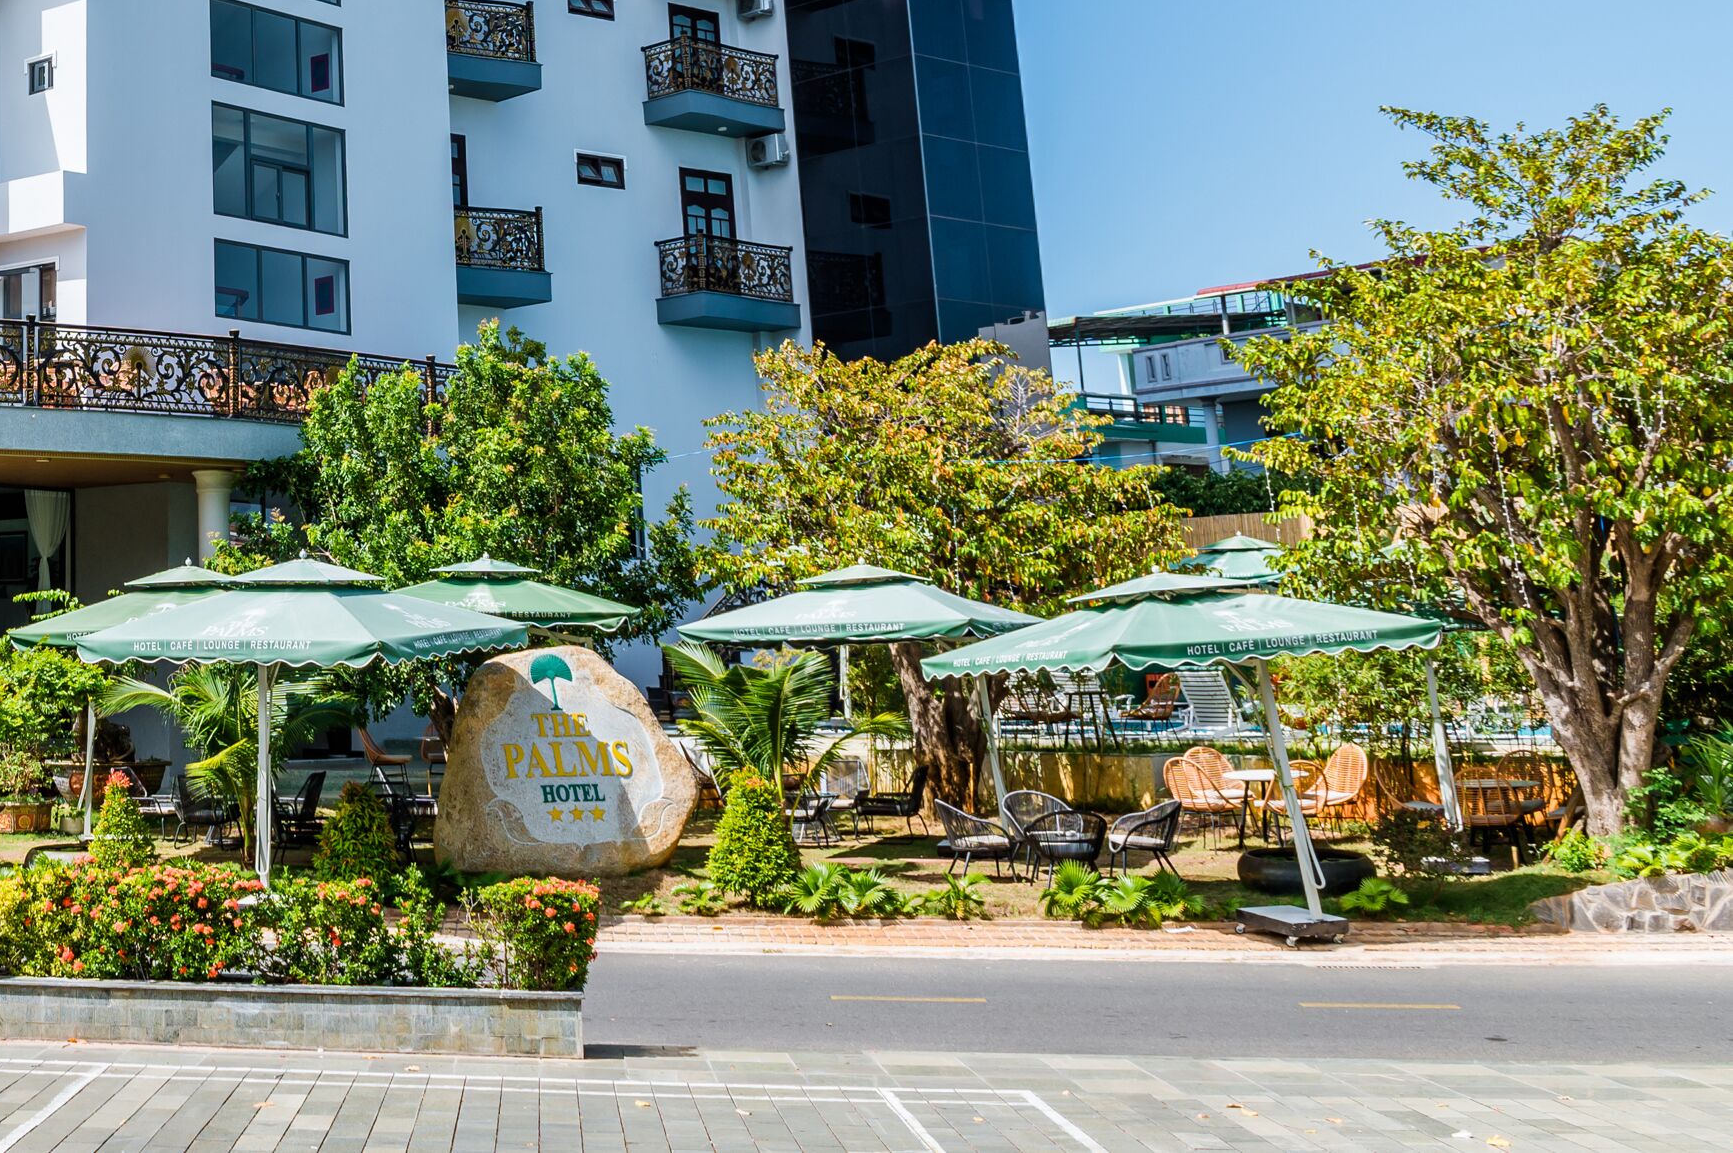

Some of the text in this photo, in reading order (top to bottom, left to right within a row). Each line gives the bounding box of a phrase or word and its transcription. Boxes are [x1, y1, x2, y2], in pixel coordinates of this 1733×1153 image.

[732, 628, 760, 637] HOTEL
[800, 624, 836, 634] LOUNGE
[846, 622, 905, 632] RESTAURANT
[133, 638, 312, 651] HOTEL CAFÉ LOUNGE RESTAURANT
[1187, 630, 1378, 656] HOTEL CAFÉ LOUNGE RESTAURANT
[953, 658, 971, 667] HOTEL
[995, 653, 1021, 663] LOUNGE
[1026, 650, 1068, 661] RESTAURANT
[531, 713, 592, 737] THE
[502, 740, 634, 779] PALMS
[540, 783, 606, 803] HOTEL
